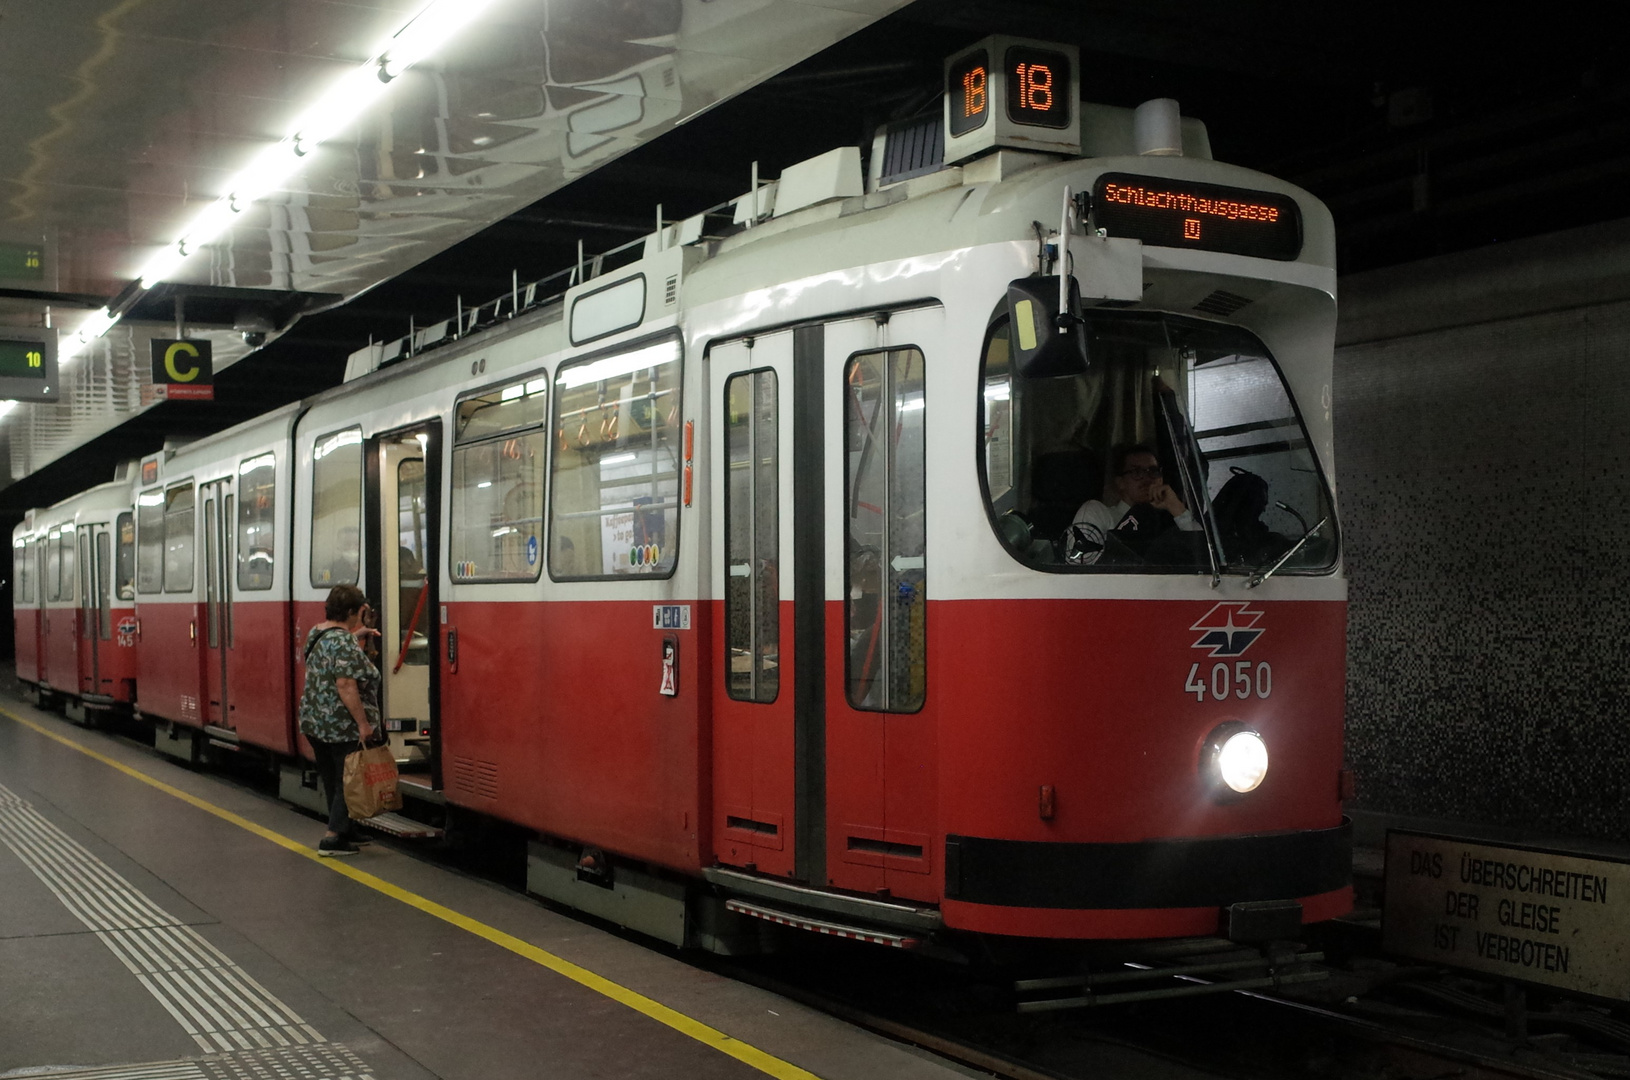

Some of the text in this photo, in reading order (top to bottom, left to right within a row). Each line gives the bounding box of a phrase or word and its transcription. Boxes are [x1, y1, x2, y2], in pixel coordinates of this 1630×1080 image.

[963, 66, 986, 117] 18
[1016, 63, 1052, 110] 18
[1105, 183, 1279, 222] Schlachthausgasse
[26, 351, 41, 367] 10
[164, 341, 200, 383] C
[1184, 660, 1272, 702] 4050
[1411, 850, 1607, 904] DAS ÜBERSCHREITEN
[1446, 891, 1560, 934] DER GLEISE
[1434, 924, 1569, 973] IST VERBOTEN
